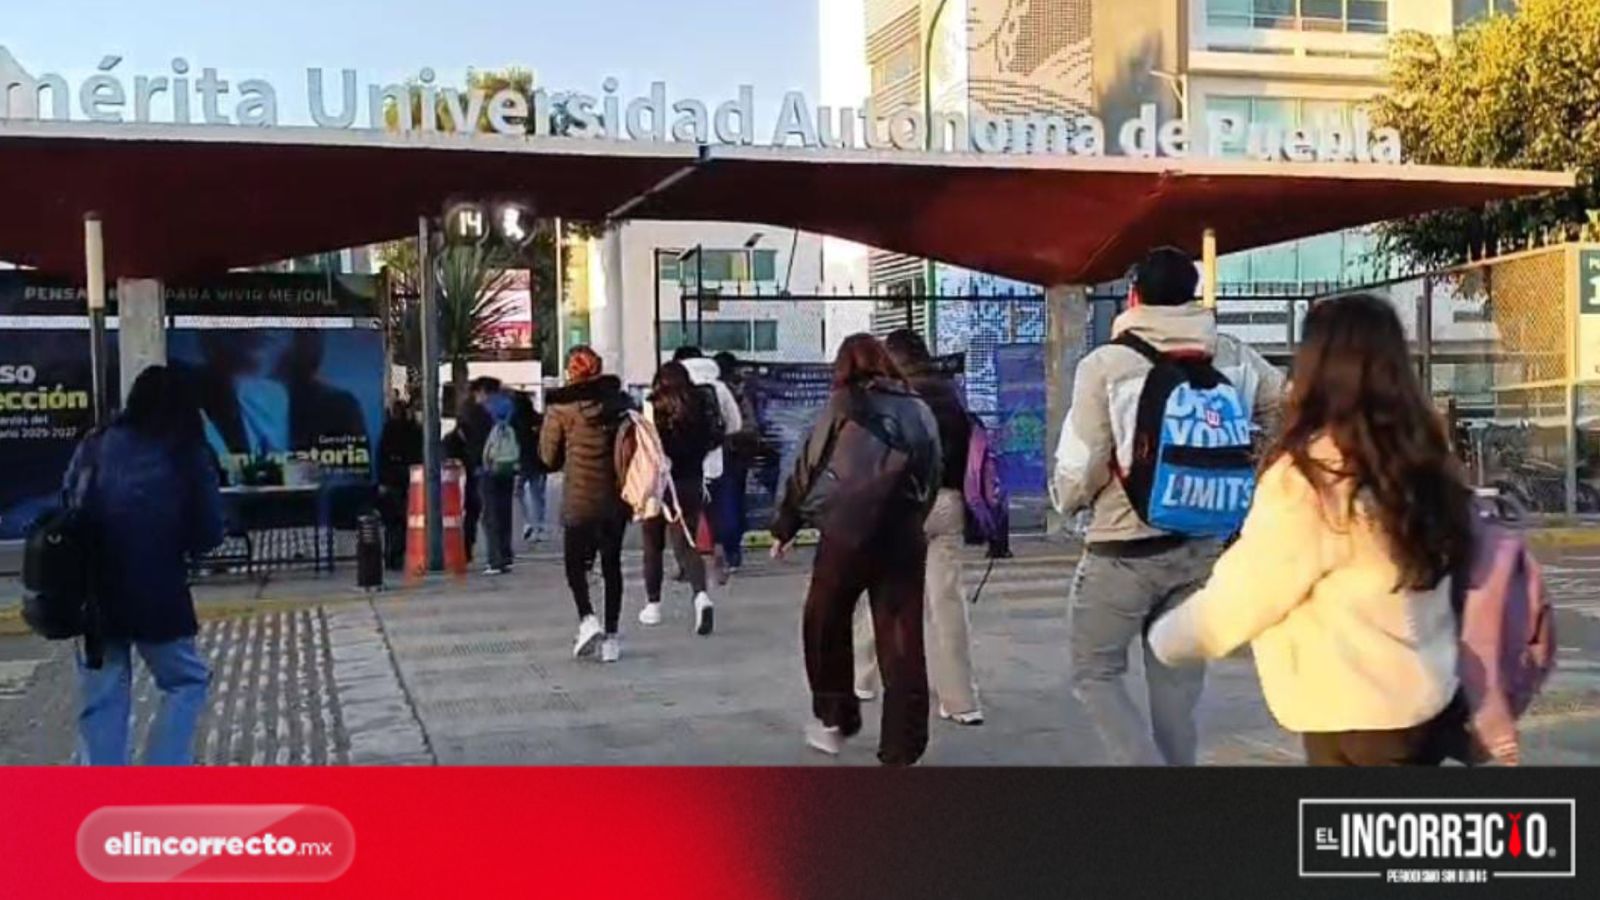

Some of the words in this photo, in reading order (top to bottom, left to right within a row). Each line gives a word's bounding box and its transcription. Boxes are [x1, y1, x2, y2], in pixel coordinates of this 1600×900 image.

[307, 68, 754, 146] Universidad
[1119, 104, 1191, 157] de
[1208, 106, 1402, 163] Puebla
[459, 211, 482, 236] 14
[25, 286, 89, 300] PENSA
[1162, 473, 1253, 511] LIMITS
